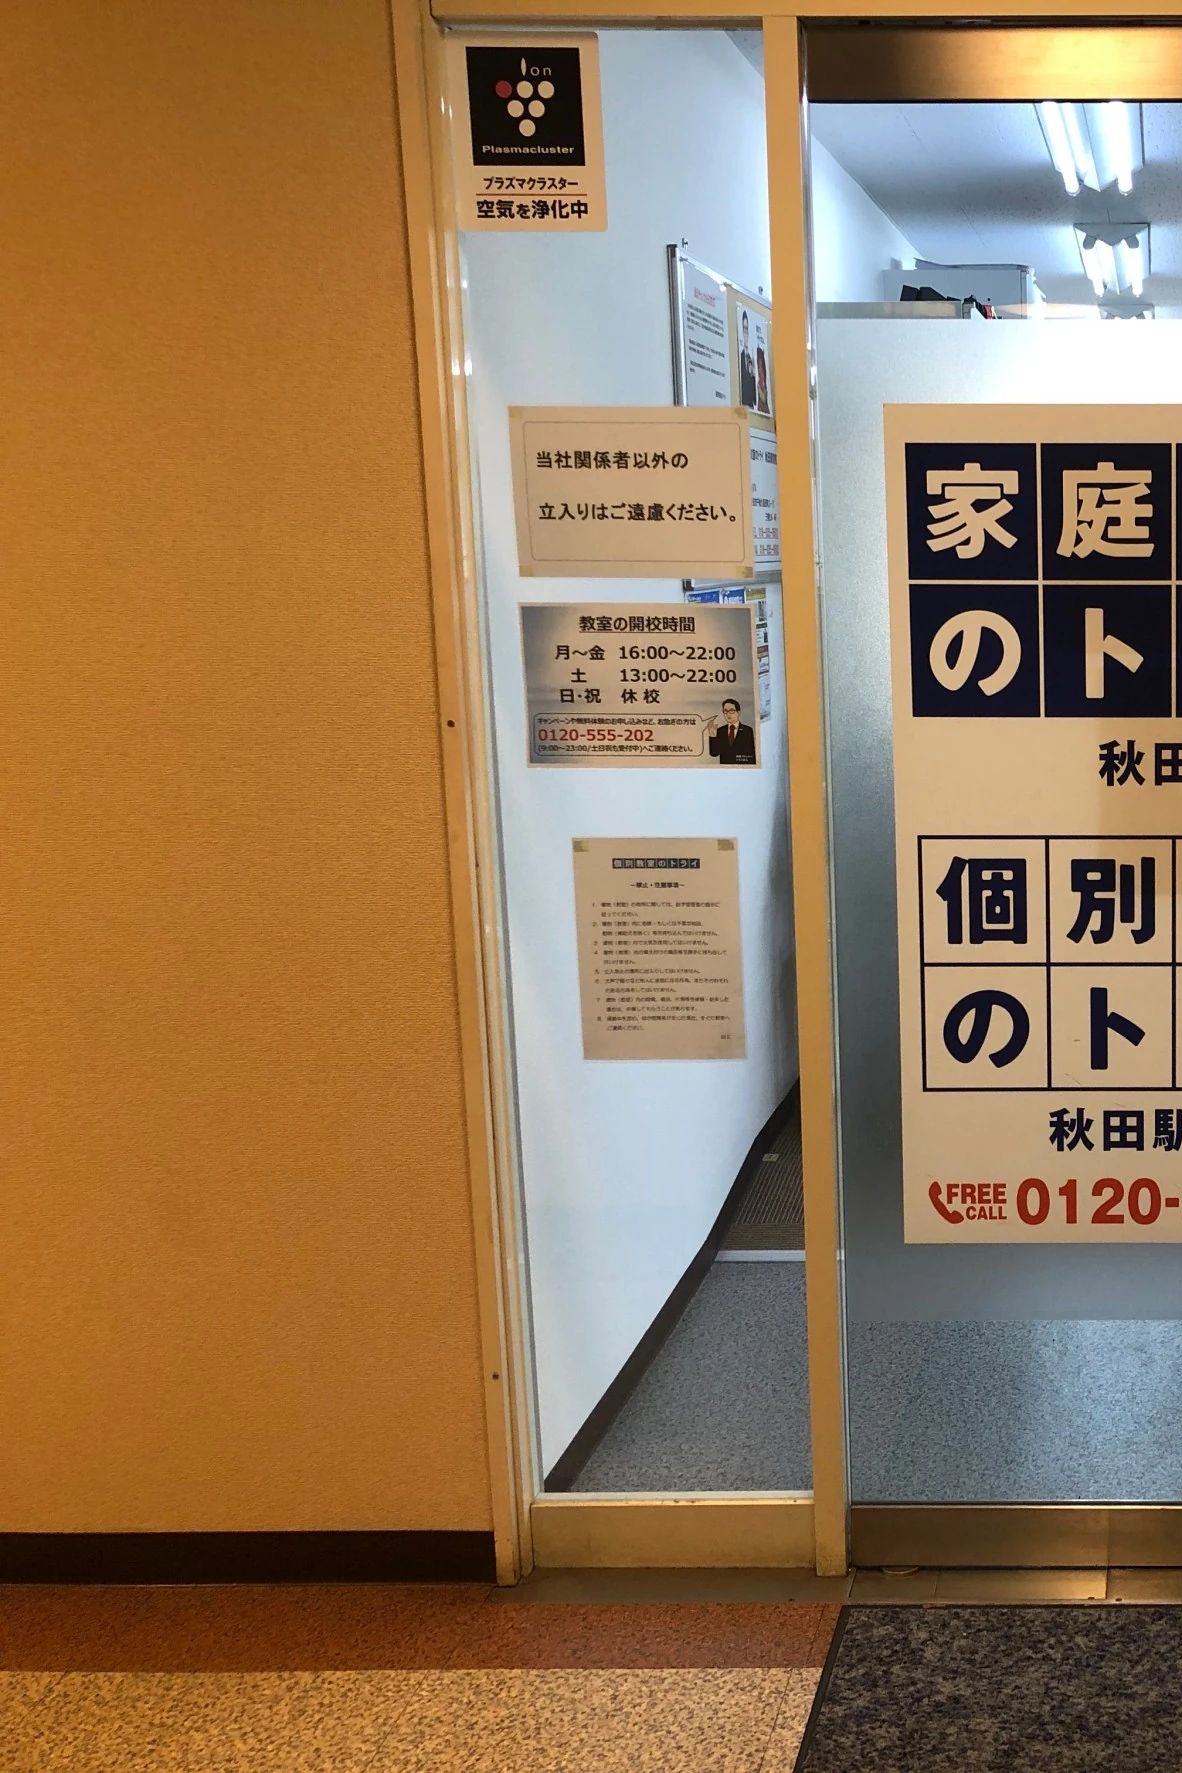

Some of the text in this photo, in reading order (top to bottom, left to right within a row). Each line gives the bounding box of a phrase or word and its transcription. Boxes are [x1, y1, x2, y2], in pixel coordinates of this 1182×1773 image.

[482, 145, 575, 154] Plasmacluster
[483, 177, 579, 190] プラズマクラスター
[477, 200, 588, 219] 空気を浄化中
[536, 451, 688, 469] 当社関係者以外の
[538, 502, 737, 522] 立入りはご遠慮ください。
[578, 616, 695, 632] 教室の開校時間
[570, 668, 587, 683] 土
[537, 728, 655, 742] 0120-555-202
[946, 1183, 1007, 1204] FREE
[965, 1204, 1007, 1221] CALL
